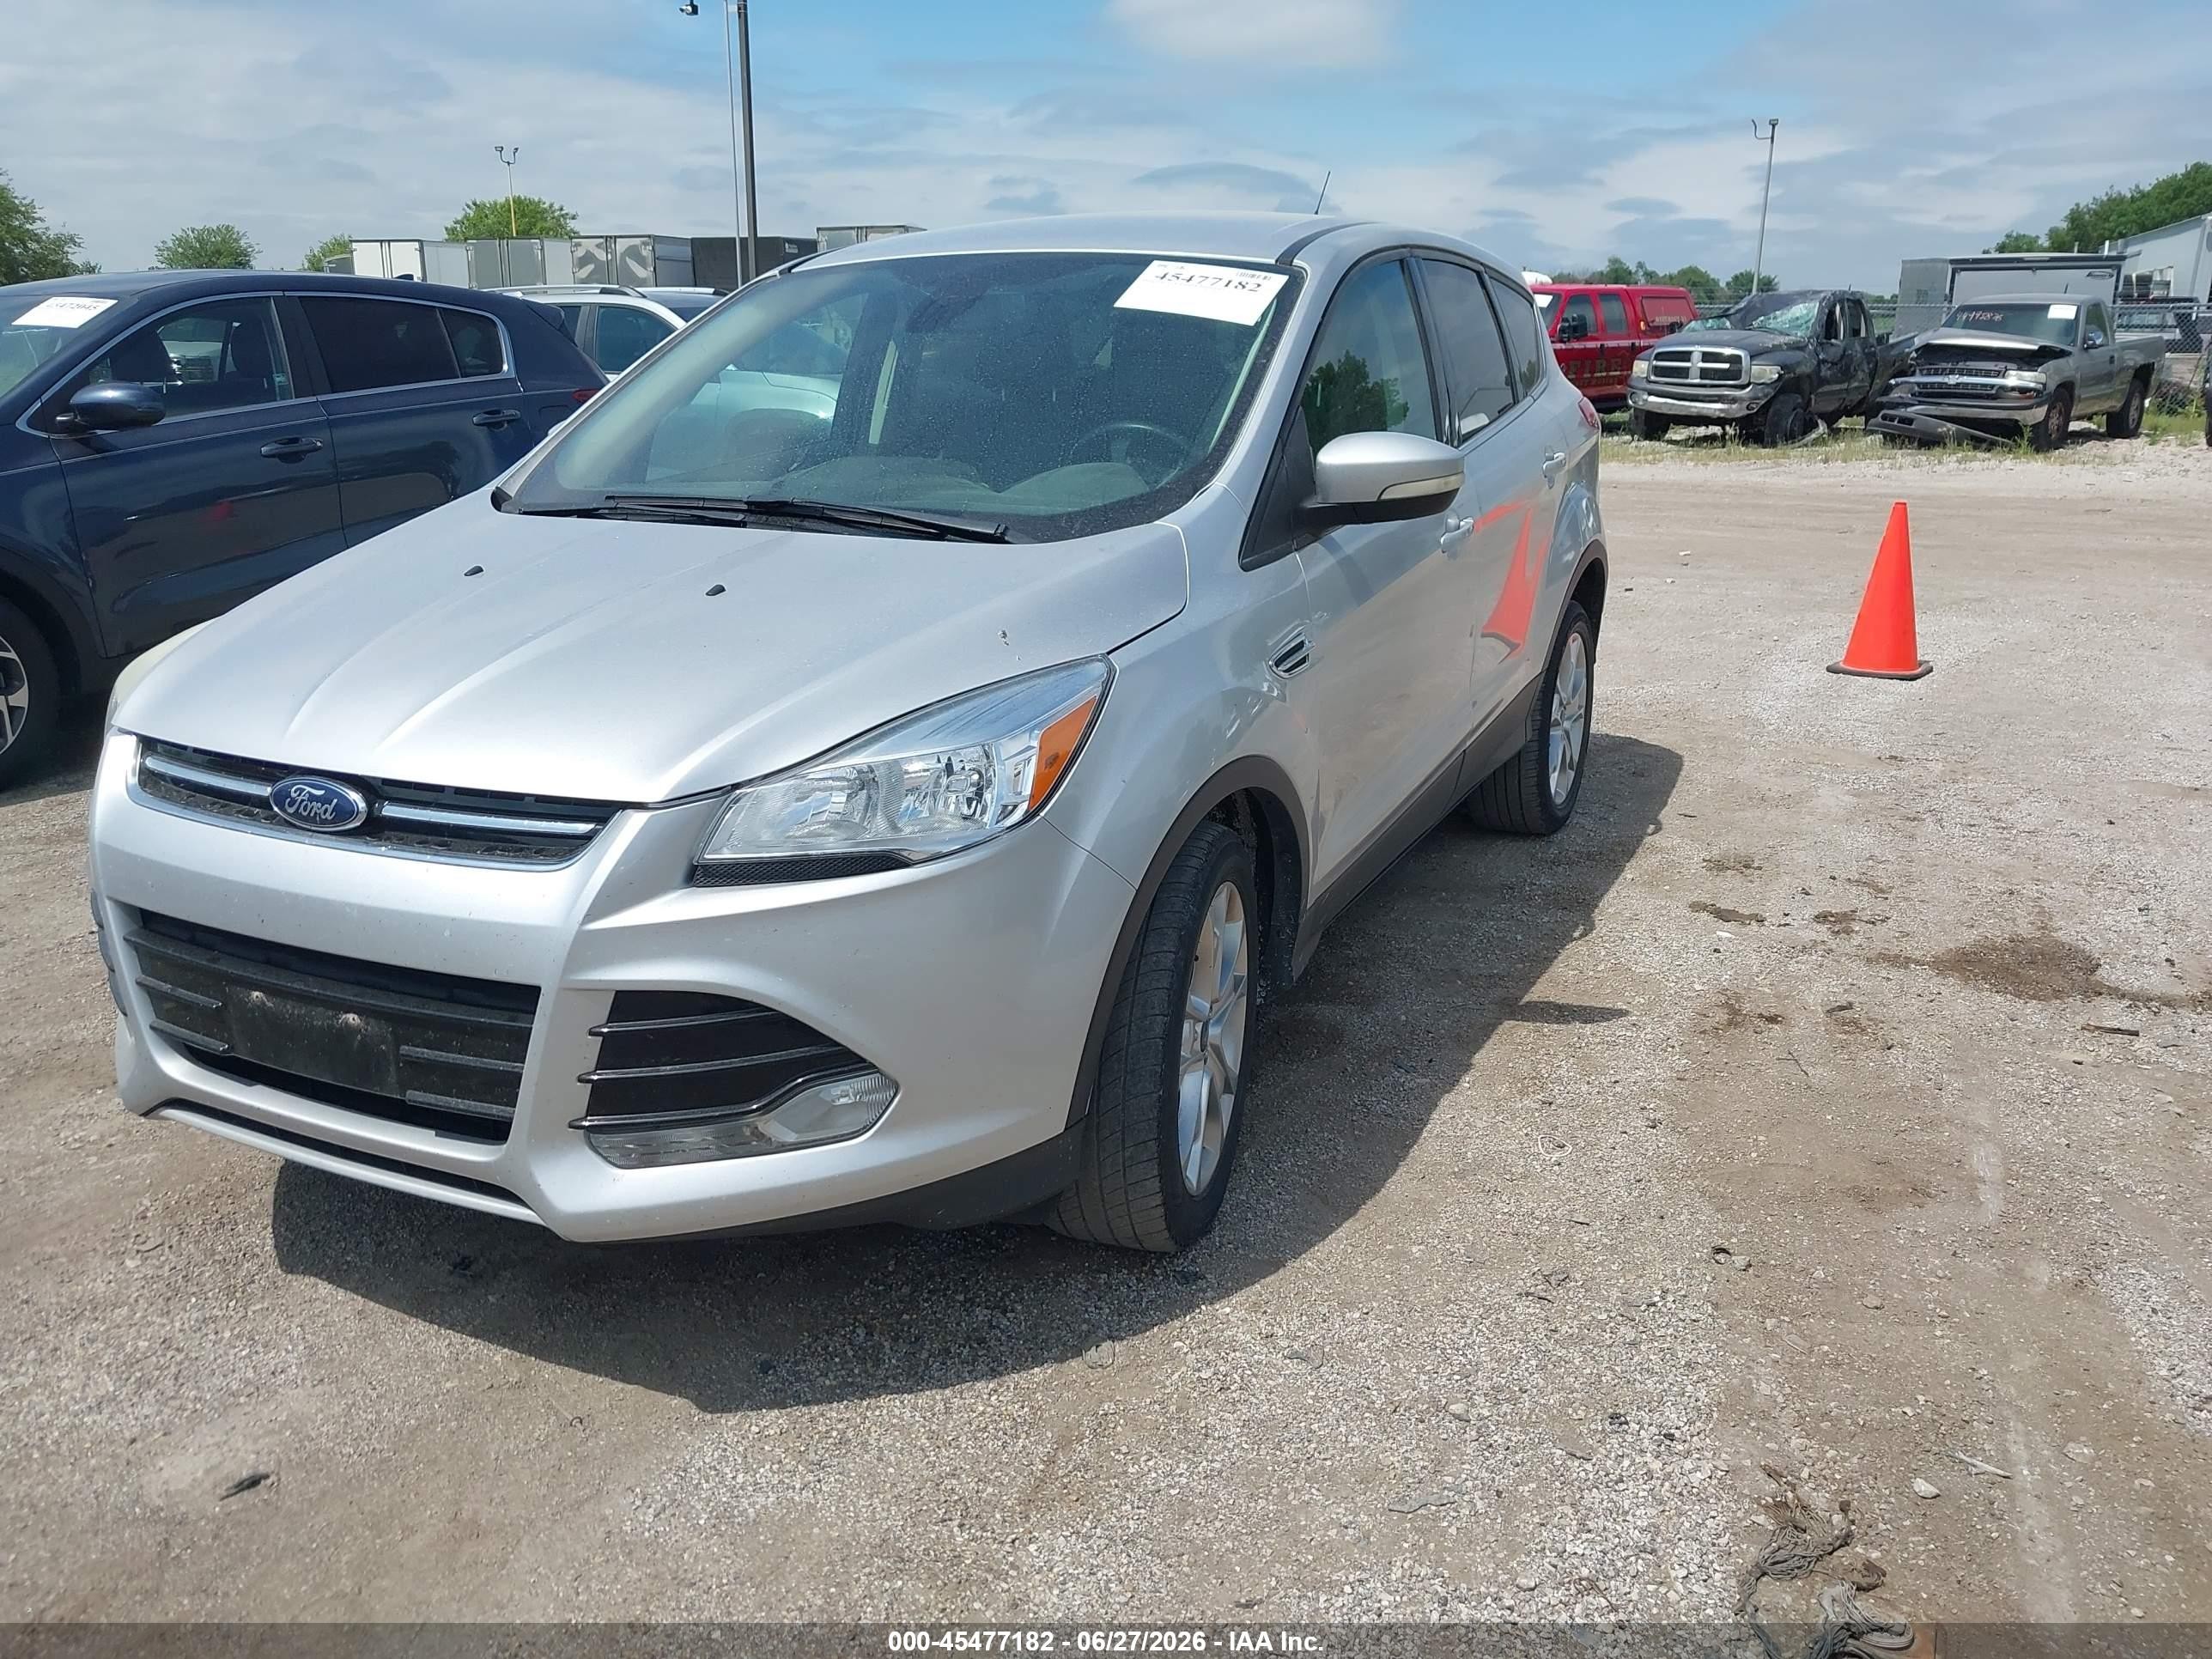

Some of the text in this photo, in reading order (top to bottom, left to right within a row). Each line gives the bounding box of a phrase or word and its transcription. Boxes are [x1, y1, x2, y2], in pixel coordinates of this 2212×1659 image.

[1154, 271, 1262, 293] 45477182
[1568, 358, 1622, 378] FIRE
[284, 784, 337, 820] Ford
